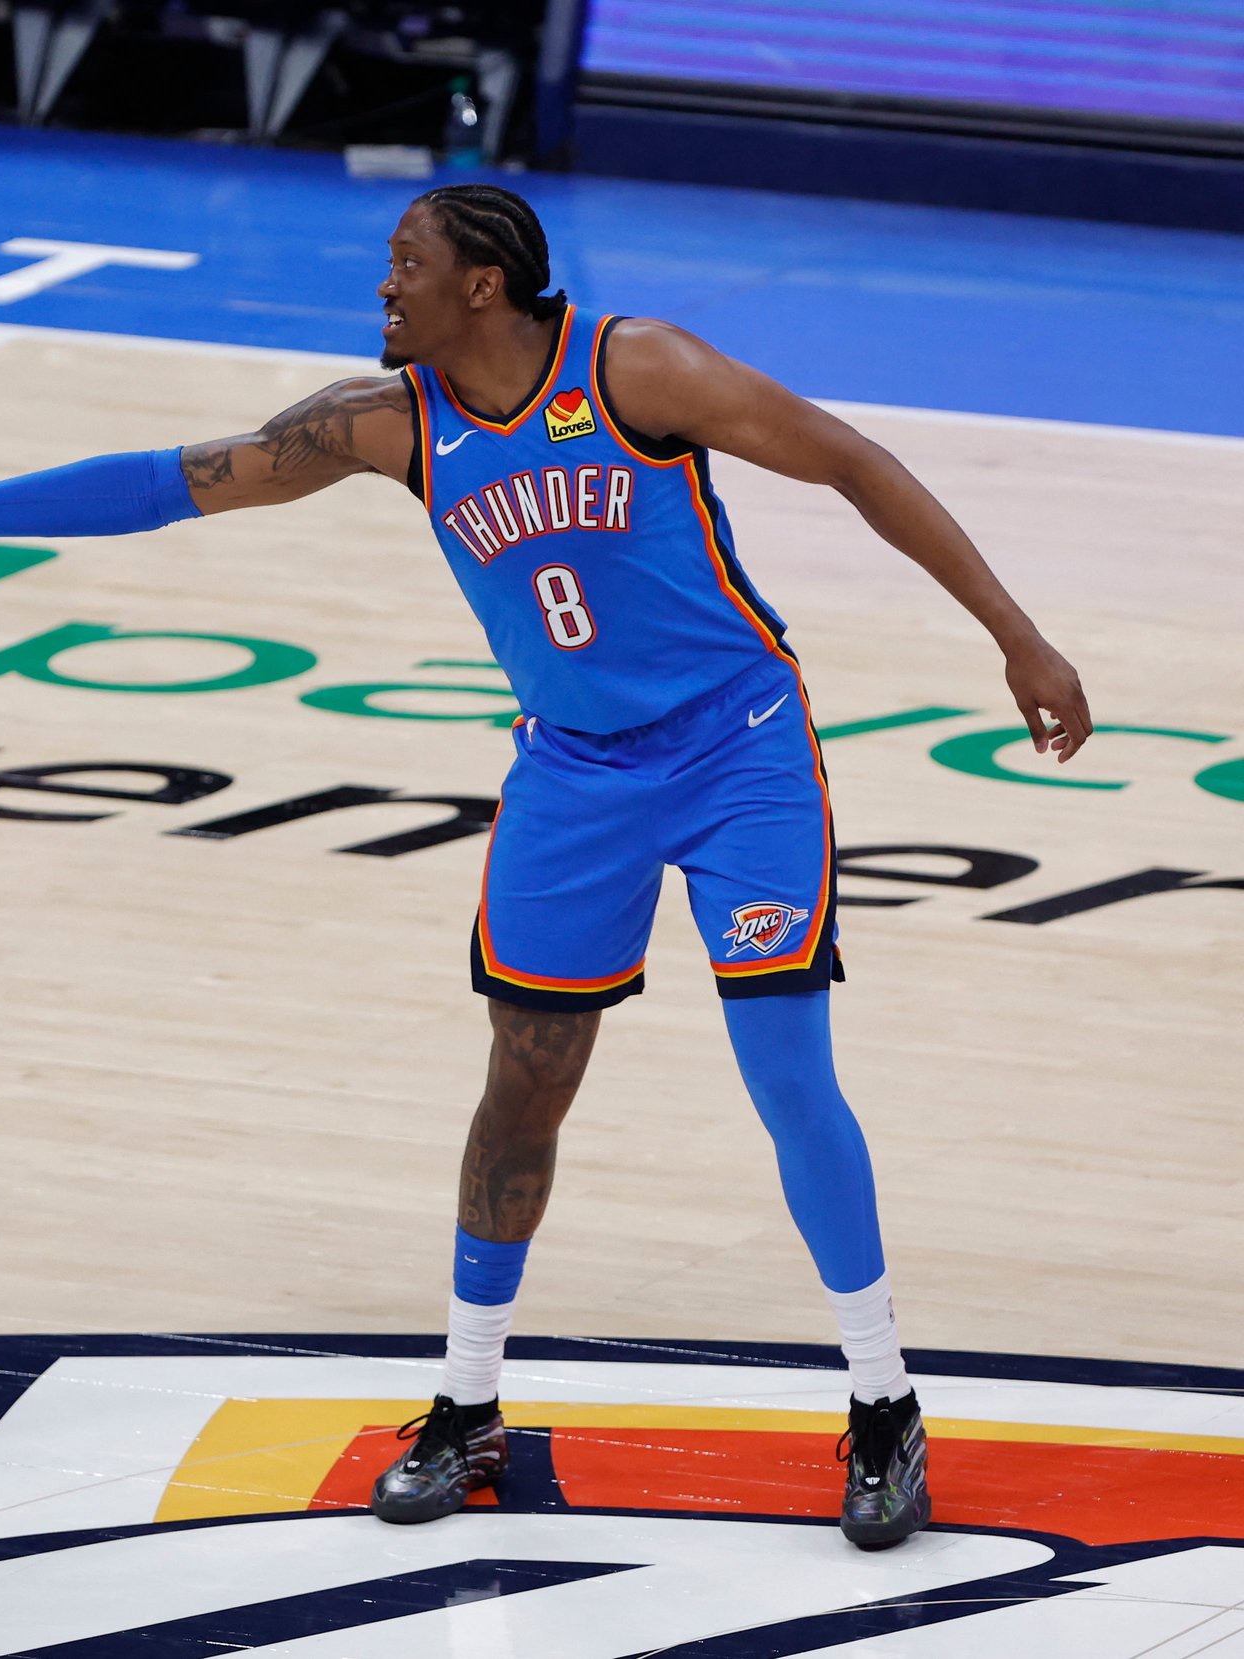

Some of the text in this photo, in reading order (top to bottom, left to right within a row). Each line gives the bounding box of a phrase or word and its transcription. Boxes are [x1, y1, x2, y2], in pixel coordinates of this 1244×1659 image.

[442, 465, 632, 566] THUNDER
[532, 563, 598, 650] 8
[736, 911, 780, 945] OKC
